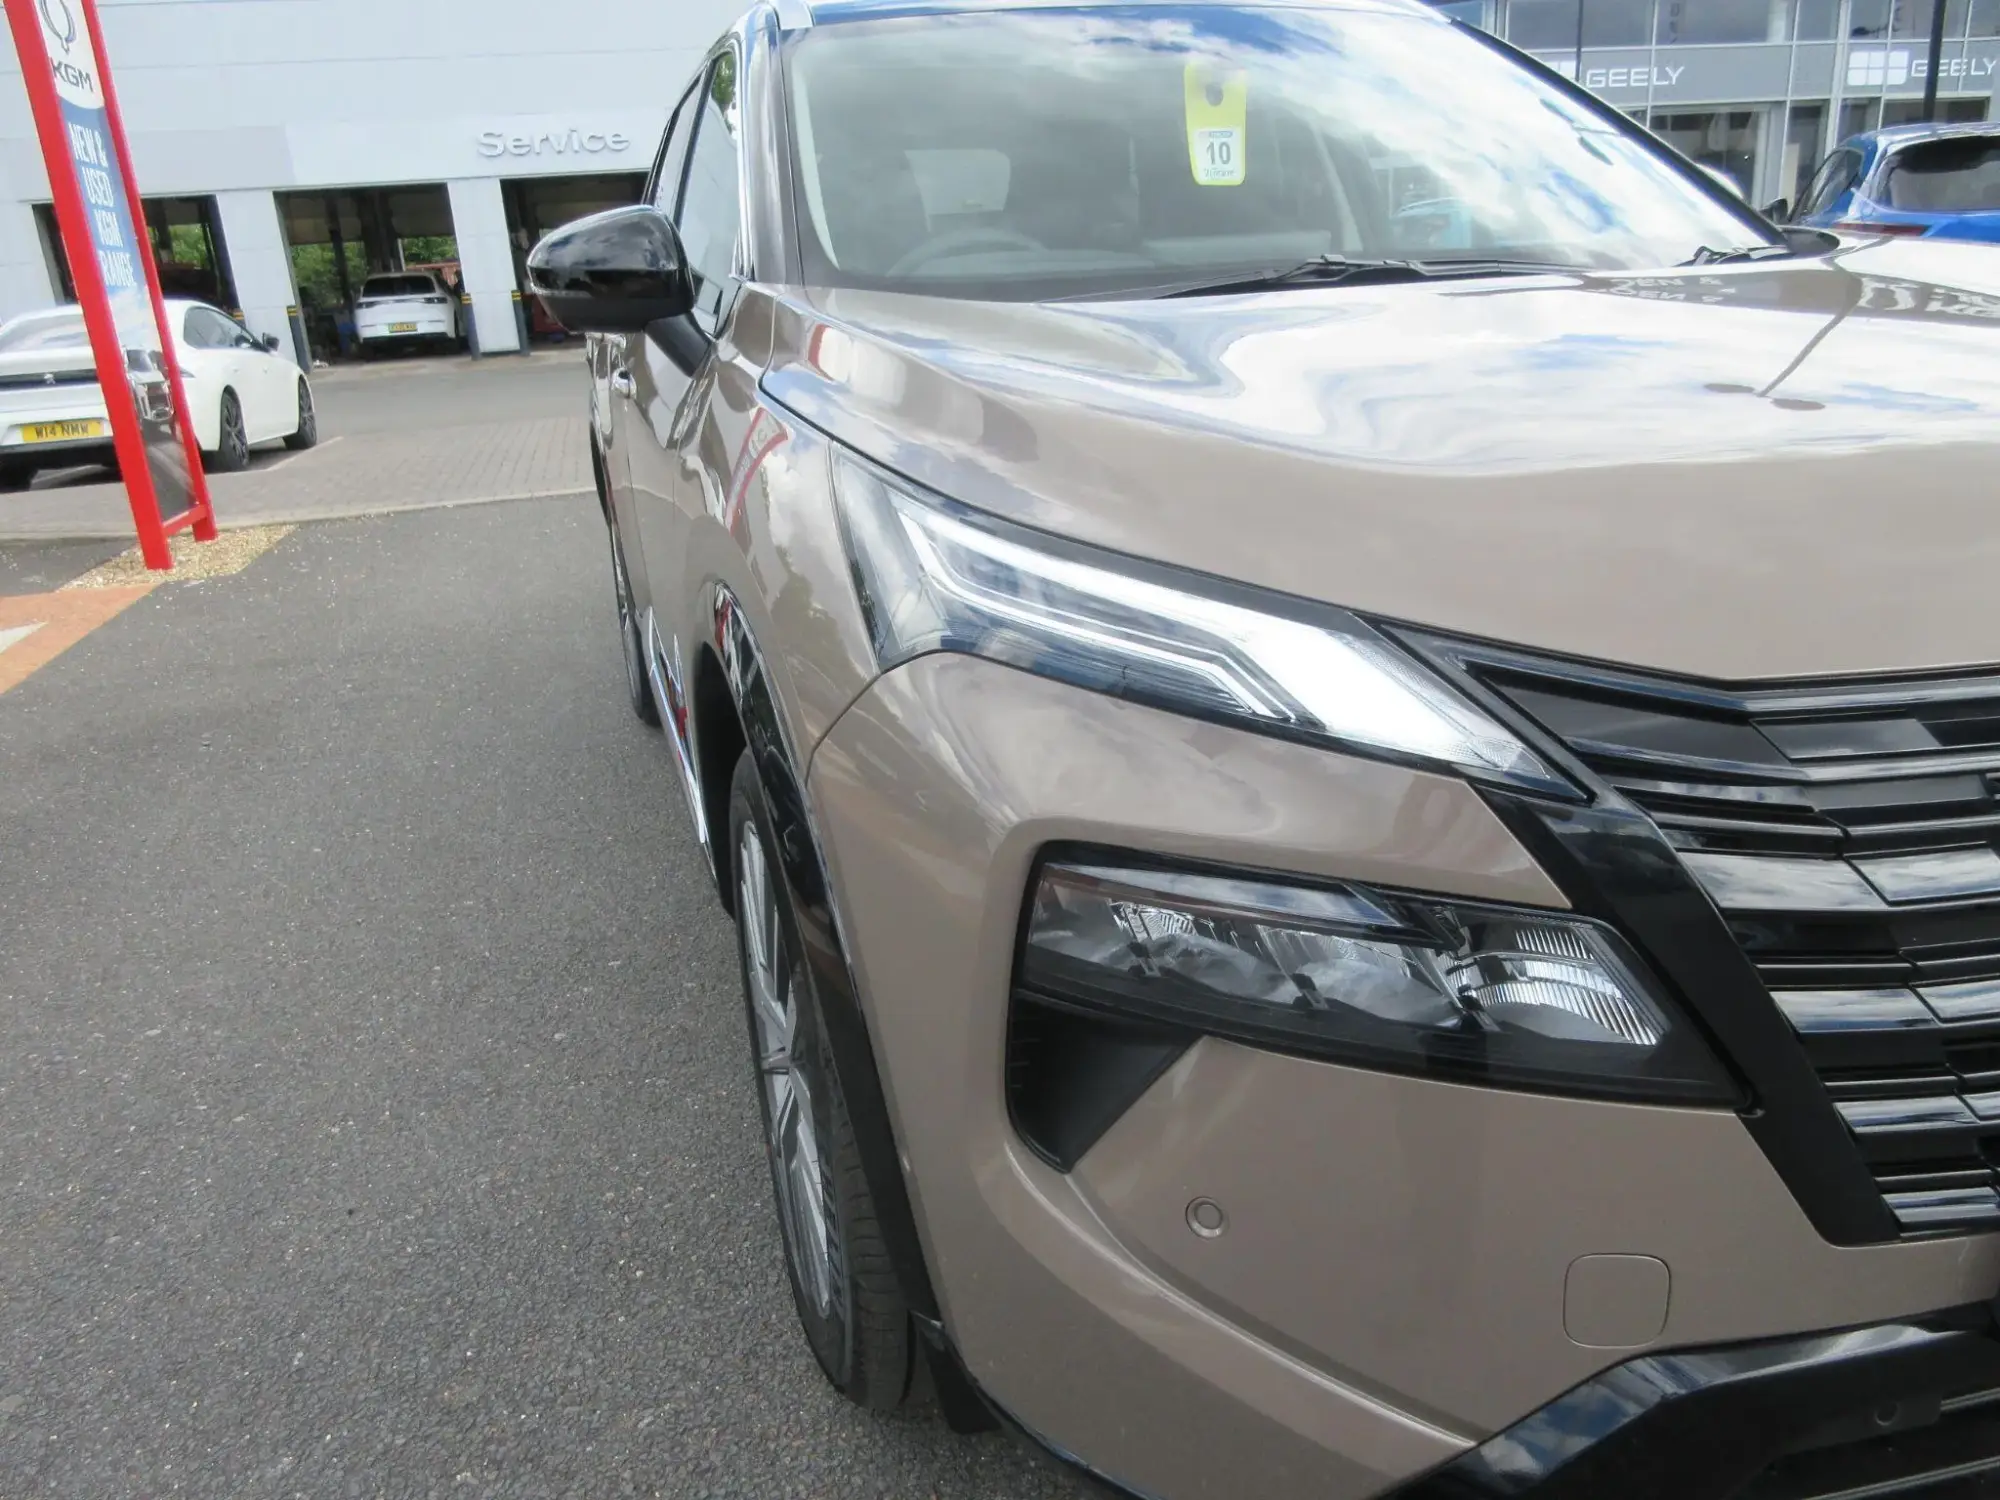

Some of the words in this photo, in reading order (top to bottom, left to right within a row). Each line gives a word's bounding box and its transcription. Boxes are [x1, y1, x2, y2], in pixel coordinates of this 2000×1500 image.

[50, 56, 95, 93] KGM
[1585, 65, 1685, 89] GEELY
[1911, 57, 1997, 78] GEELY
[68, 122, 98, 165] NEW
[94, 129, 109, 169] &
[477, 127, 631, 158] Service
[1206, 141, 1231, 166] 10
[82, 166, 115, 208] USED
[93, 208, 124, 249] KGM
[99, 250, 138, 288] RANGE
